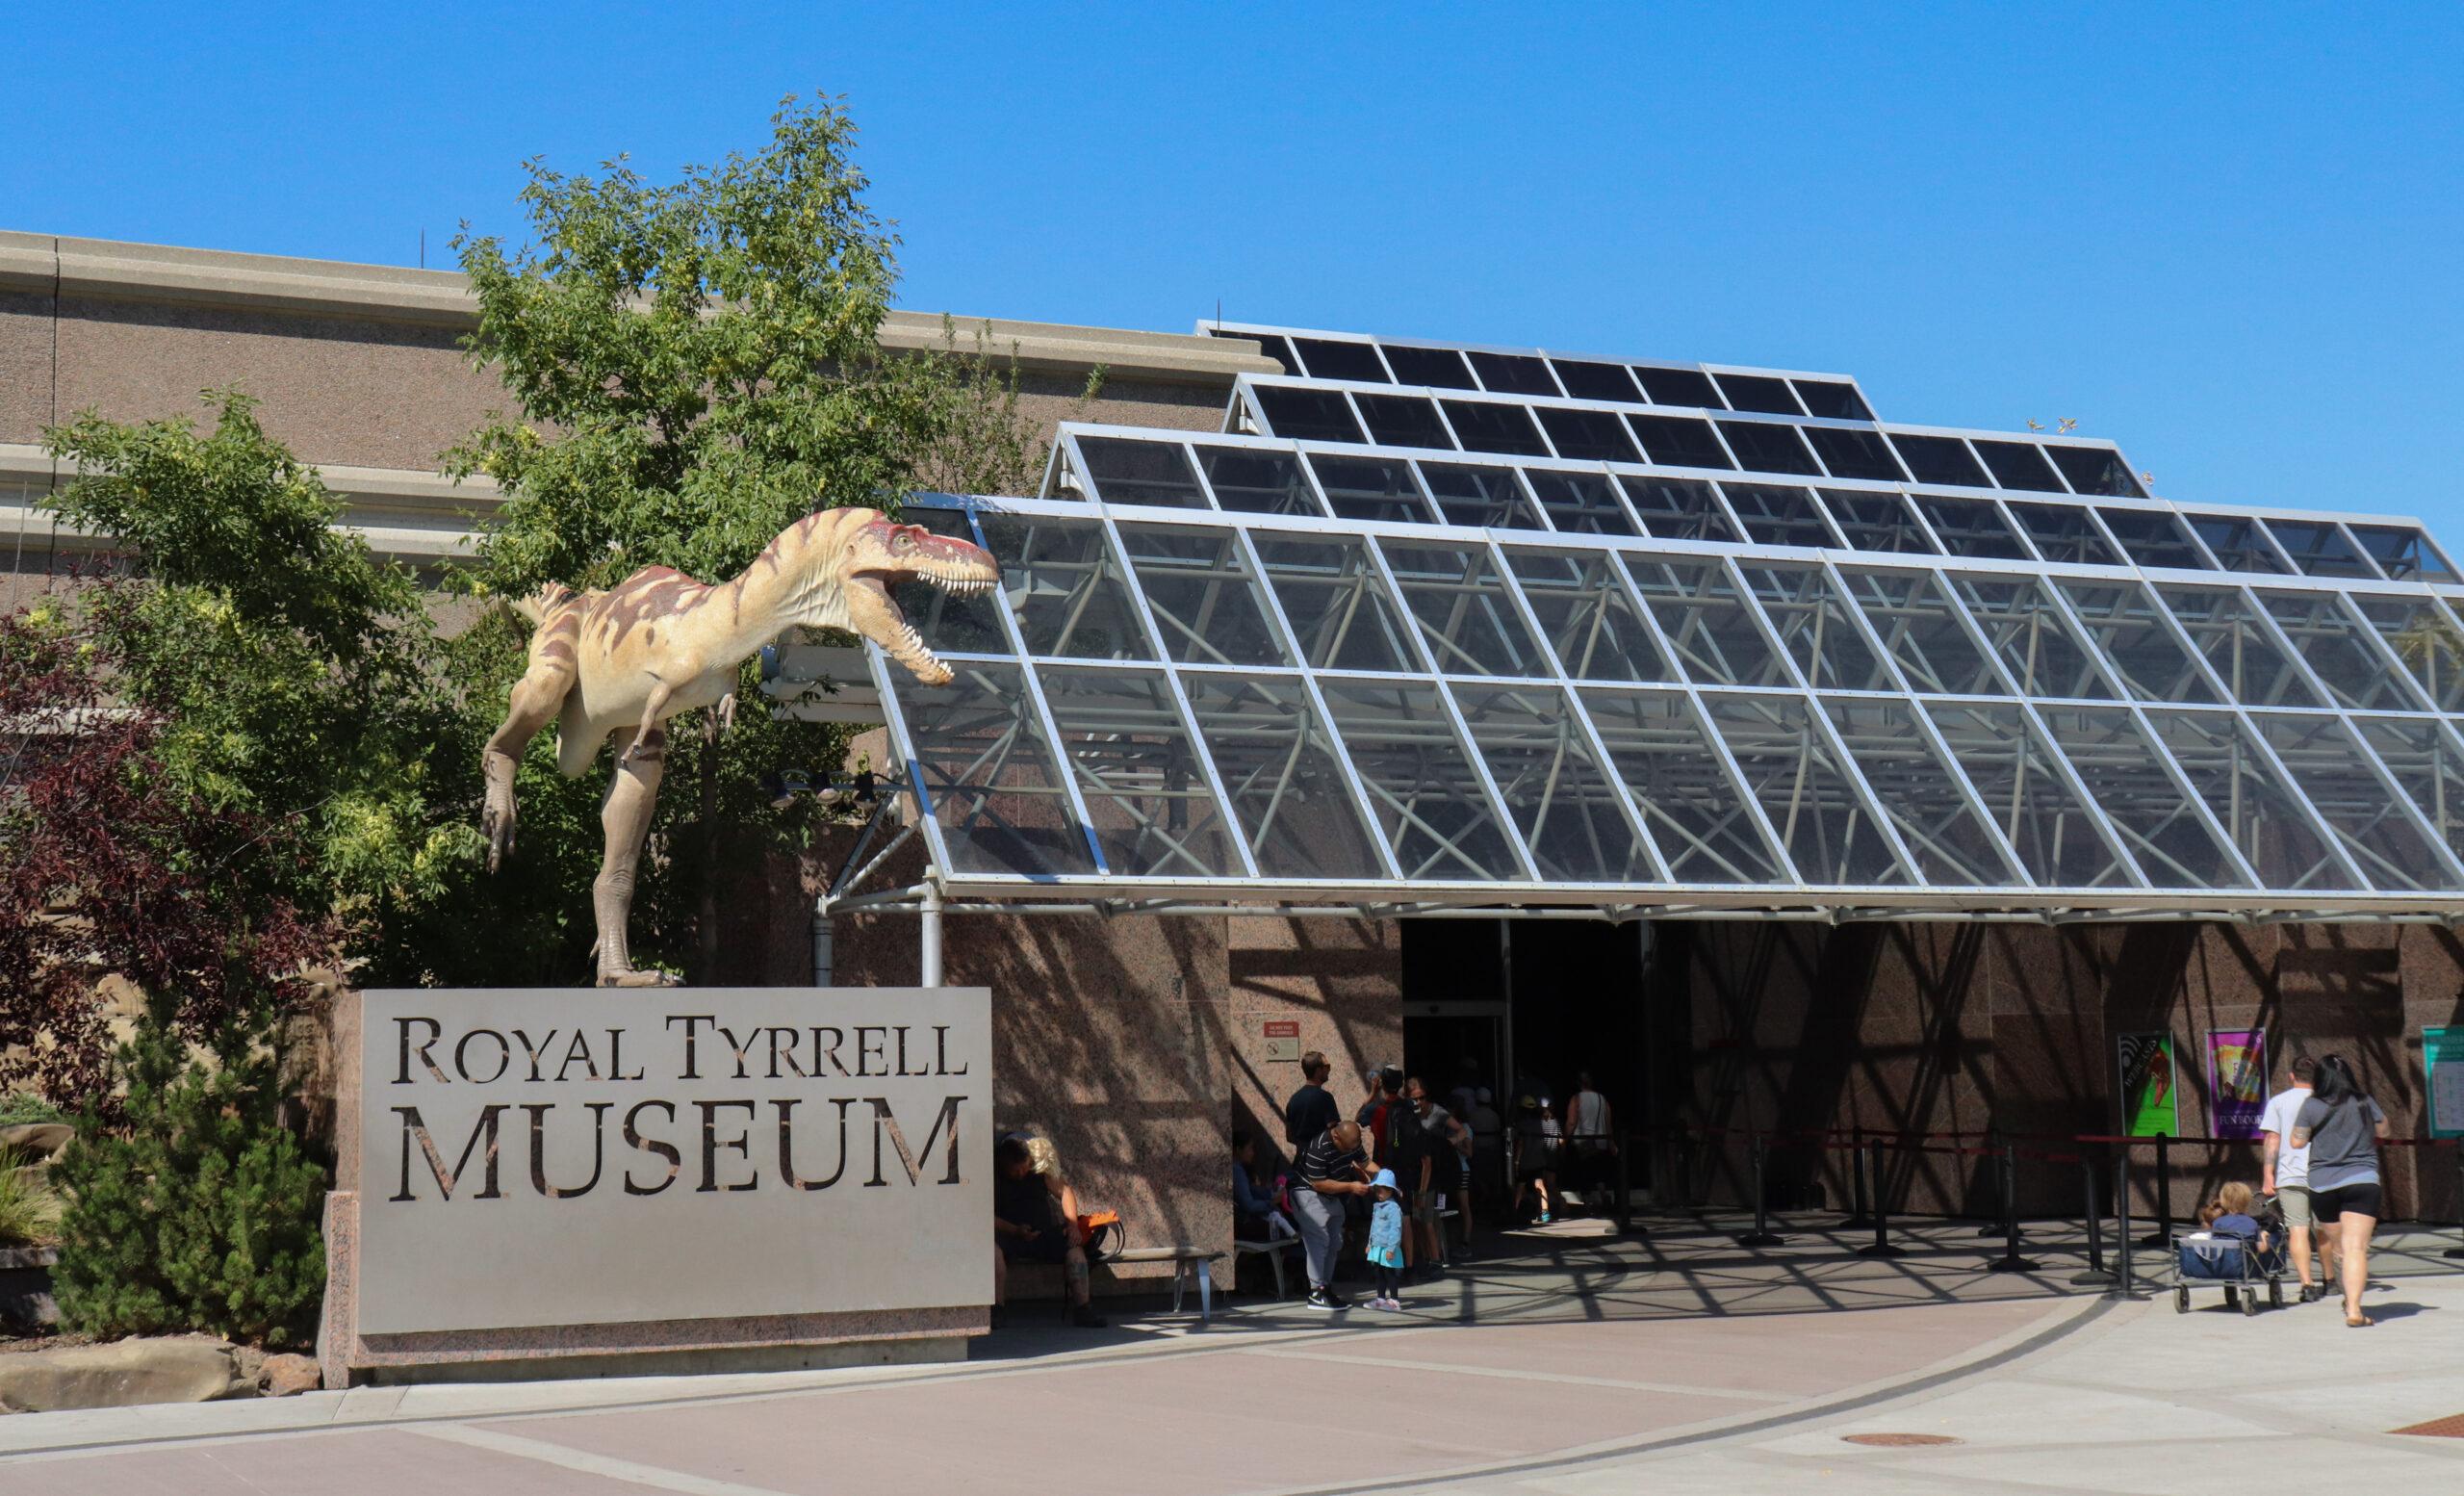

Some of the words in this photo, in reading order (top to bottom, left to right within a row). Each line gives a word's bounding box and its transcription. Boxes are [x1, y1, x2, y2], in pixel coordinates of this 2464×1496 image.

[391, 1017, 645, 1084] ROYAL
[666, 1015, 968, 1079] TYRRELL
[389, 1096, 969, 1201] MUSEUM
[2220, 1115, 2237, 1124] FUN
